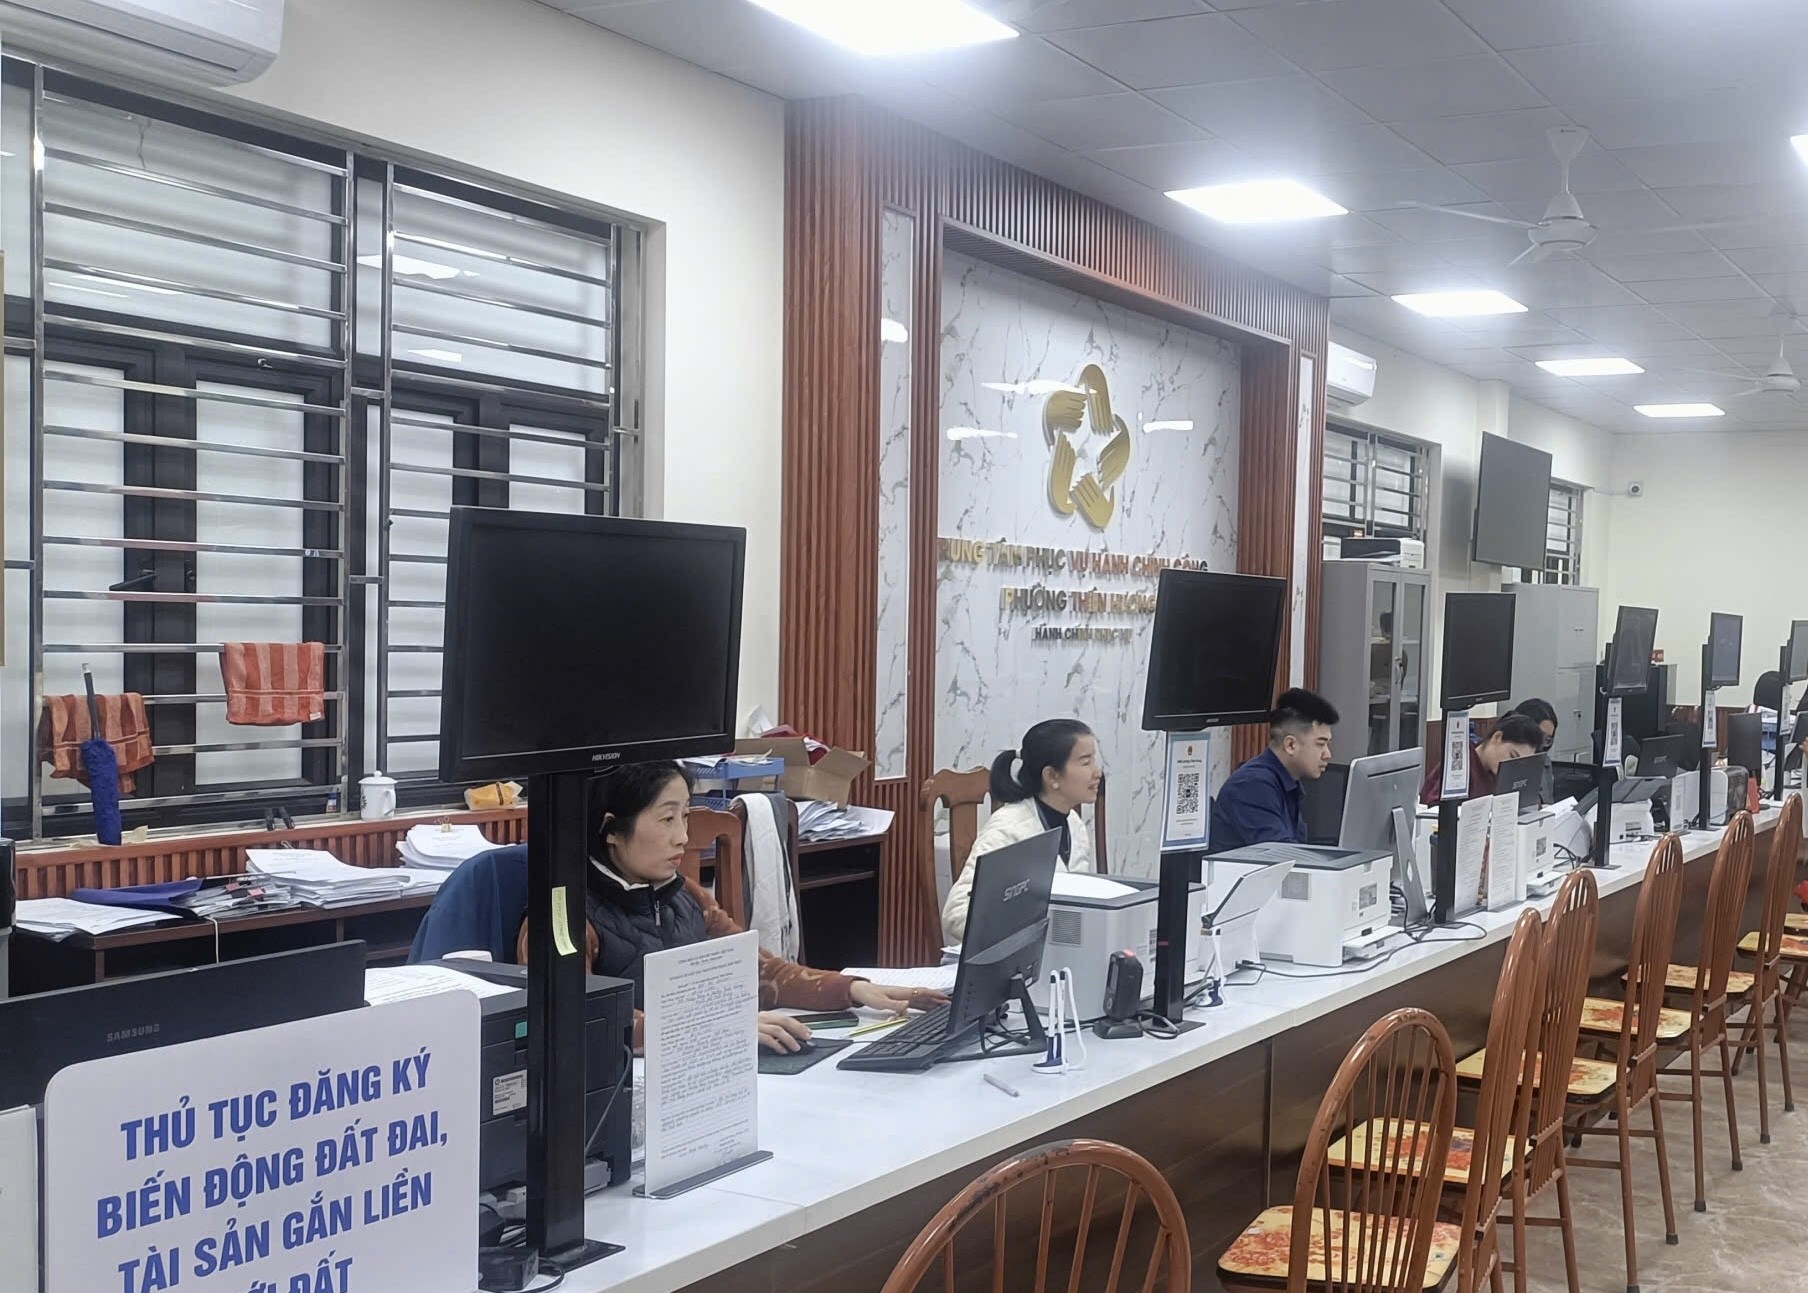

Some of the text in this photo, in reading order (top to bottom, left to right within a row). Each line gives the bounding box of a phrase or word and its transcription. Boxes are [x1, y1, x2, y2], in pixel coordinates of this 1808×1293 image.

[937, 537, 985, 564] RUNG
[986, 537, 1024, 566] TÂM
[1025, 546, 1066, 575] PHỤC
[1067, 551, 1089, 578] VỤ
[1090, 548, 1129, 575] HÀNH
[1000, 582, 1067, 613] PHƯỜNG
[106, 1023, 160, 1042] SAMSUNG
[121, 1095, 196, 1161] THỦ
[208, 1089, 277, 1142] TỤC
[289, 1067, 381, 1120] ĐĂNG
[392, 1046, 431, 1094] KÝ
[97, 1111, 448, 1238] BIẾN ĐỘNG ĐẤT ĐAI,
[118, 1167, 432, 1293] TÀI SẢN GẮN LIỀN
